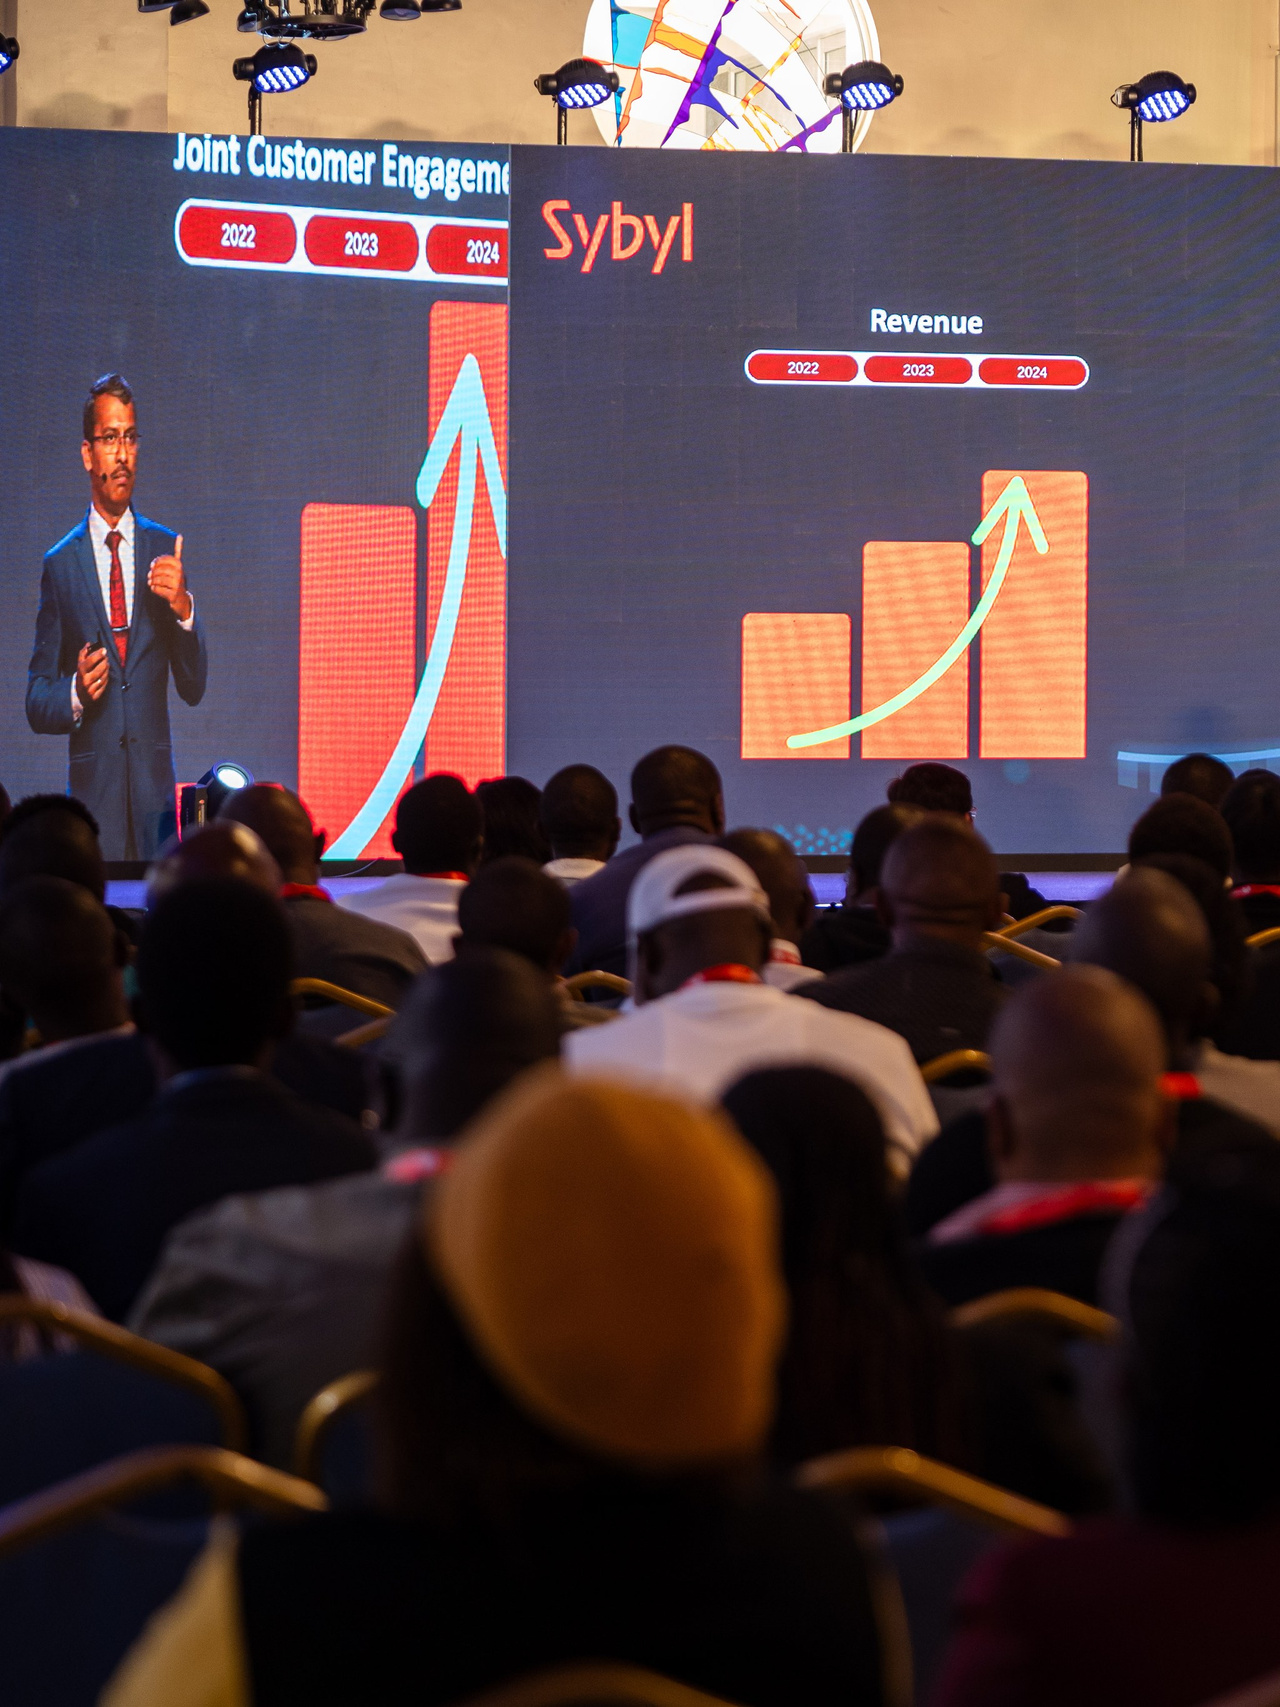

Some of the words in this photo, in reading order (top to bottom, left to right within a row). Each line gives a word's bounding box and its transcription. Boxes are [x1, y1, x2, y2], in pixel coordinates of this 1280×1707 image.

[173, 132, 241, 175] Joint
[247, 135, 376, 185] Customer
[221, 223, 256, 248] 2022
[344, 231, 379, 257] 2023
[541, 199, 694, 274] Sybyl
[466, 240, 500, 264] 2024
[870, 308, 983, 334] Revenue
[787, 361, 819, 375] 2022
[903, 363, 935, 377] 2023
[1017, 365, 1048, 379] 2024
